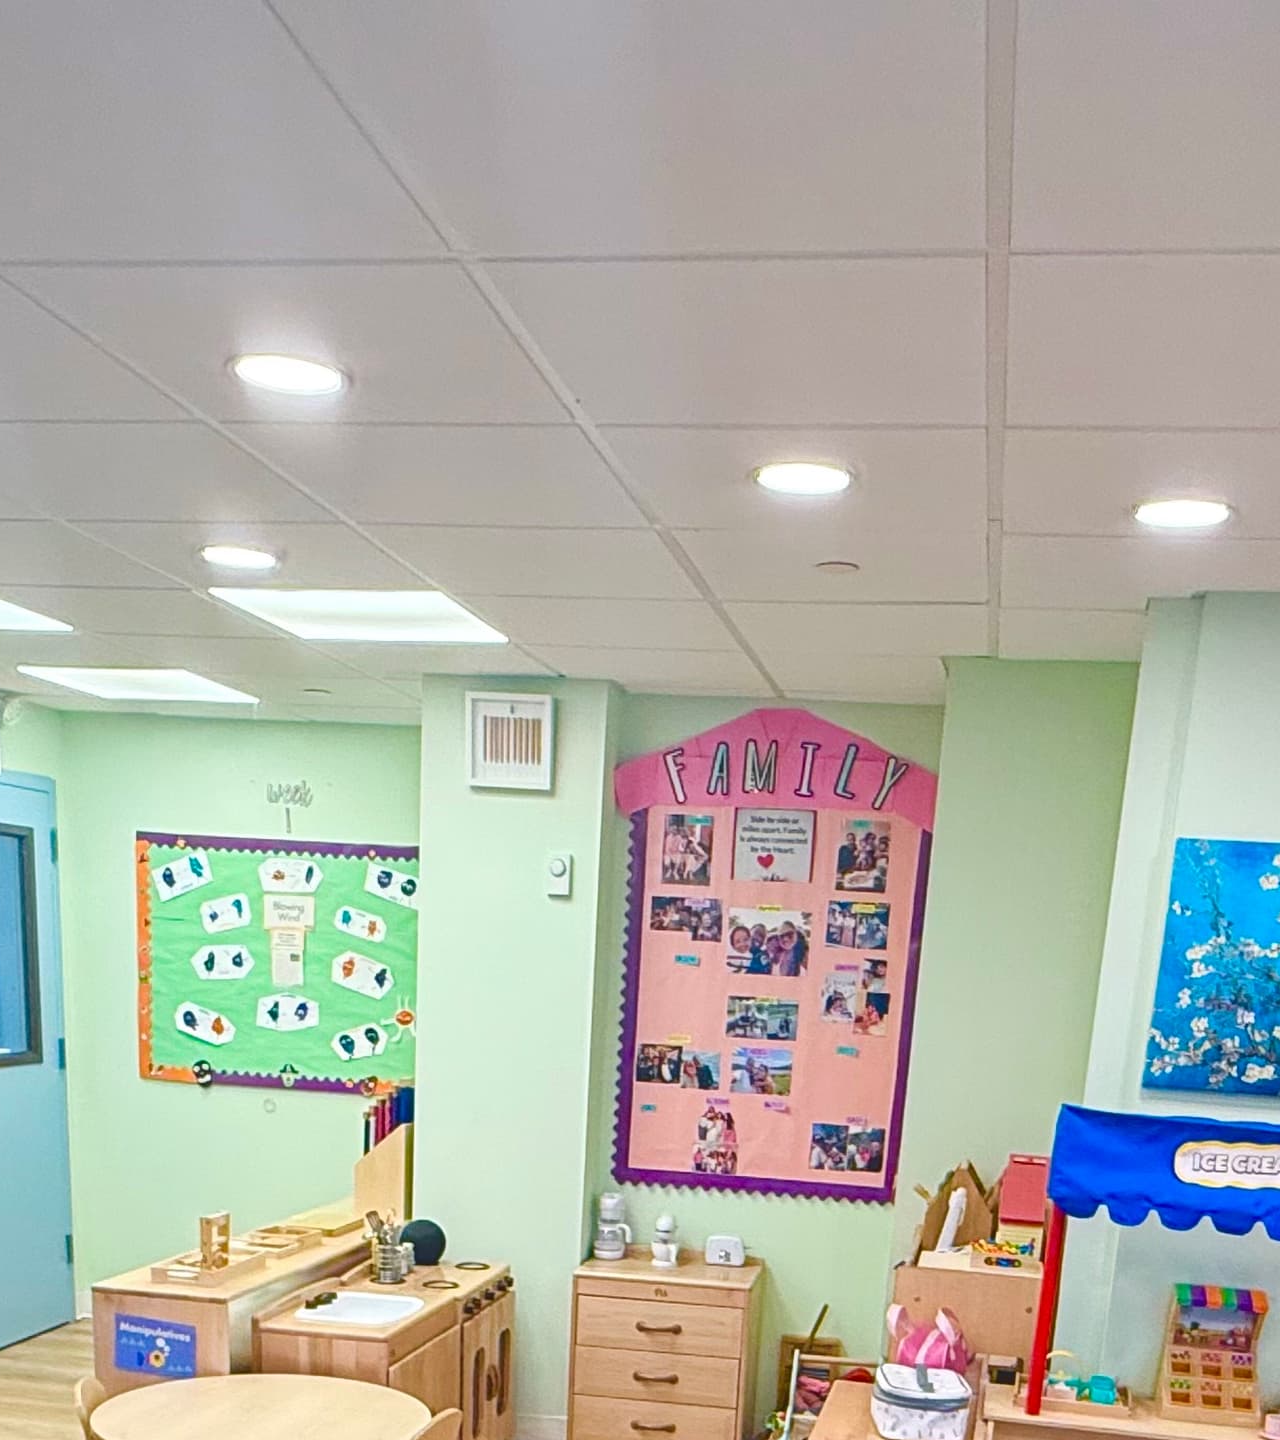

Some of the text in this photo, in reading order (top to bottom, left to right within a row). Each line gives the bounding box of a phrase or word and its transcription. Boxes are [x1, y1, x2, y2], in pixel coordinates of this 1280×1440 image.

[664, 739, 909, 810] FAMILY
[273, 901, 305, 914] Blowing
[278, 912, 301, 922] Wind
[1192, 1152, 1228, 1173] ICE
